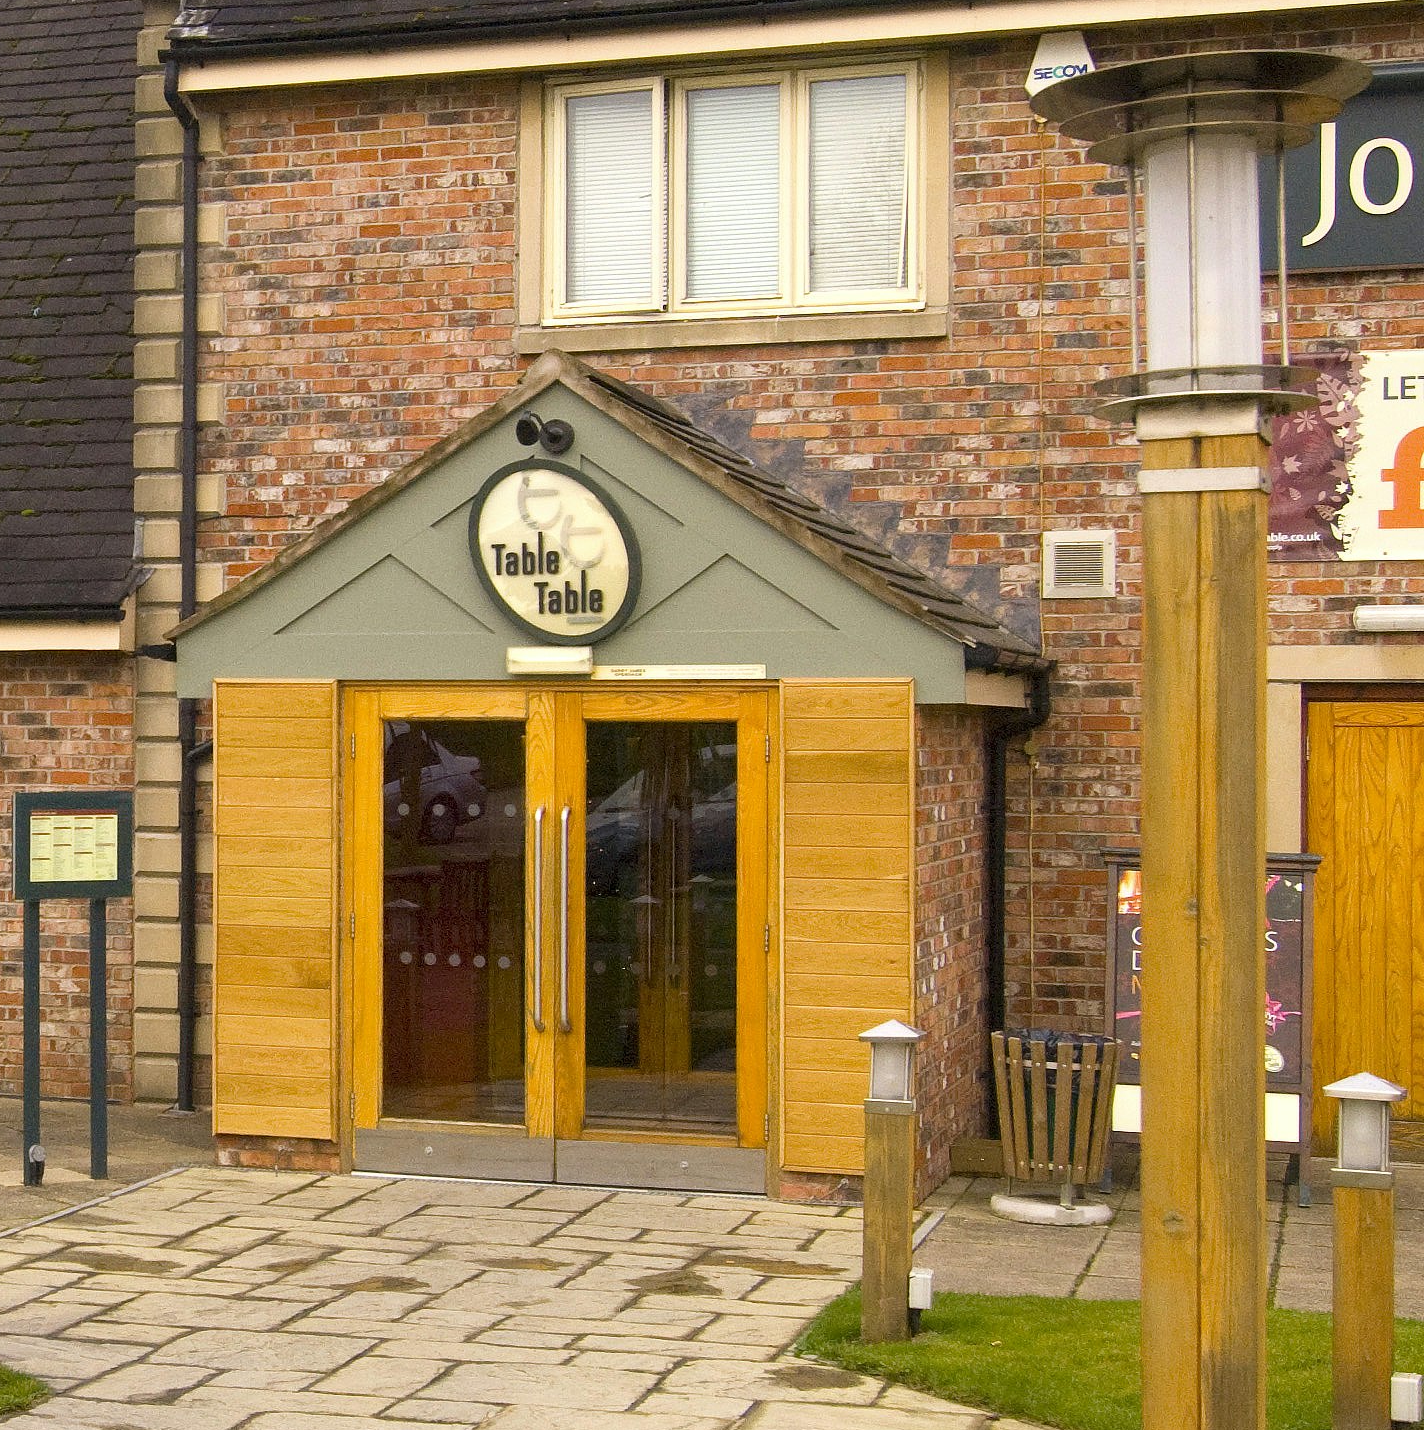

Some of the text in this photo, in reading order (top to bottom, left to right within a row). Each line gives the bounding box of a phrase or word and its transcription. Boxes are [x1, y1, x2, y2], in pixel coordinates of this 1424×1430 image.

[1033, 63, 1088, 81] SECOM
[491, 531, 560, 576] Table
[533, 569, 603, 615] Table
